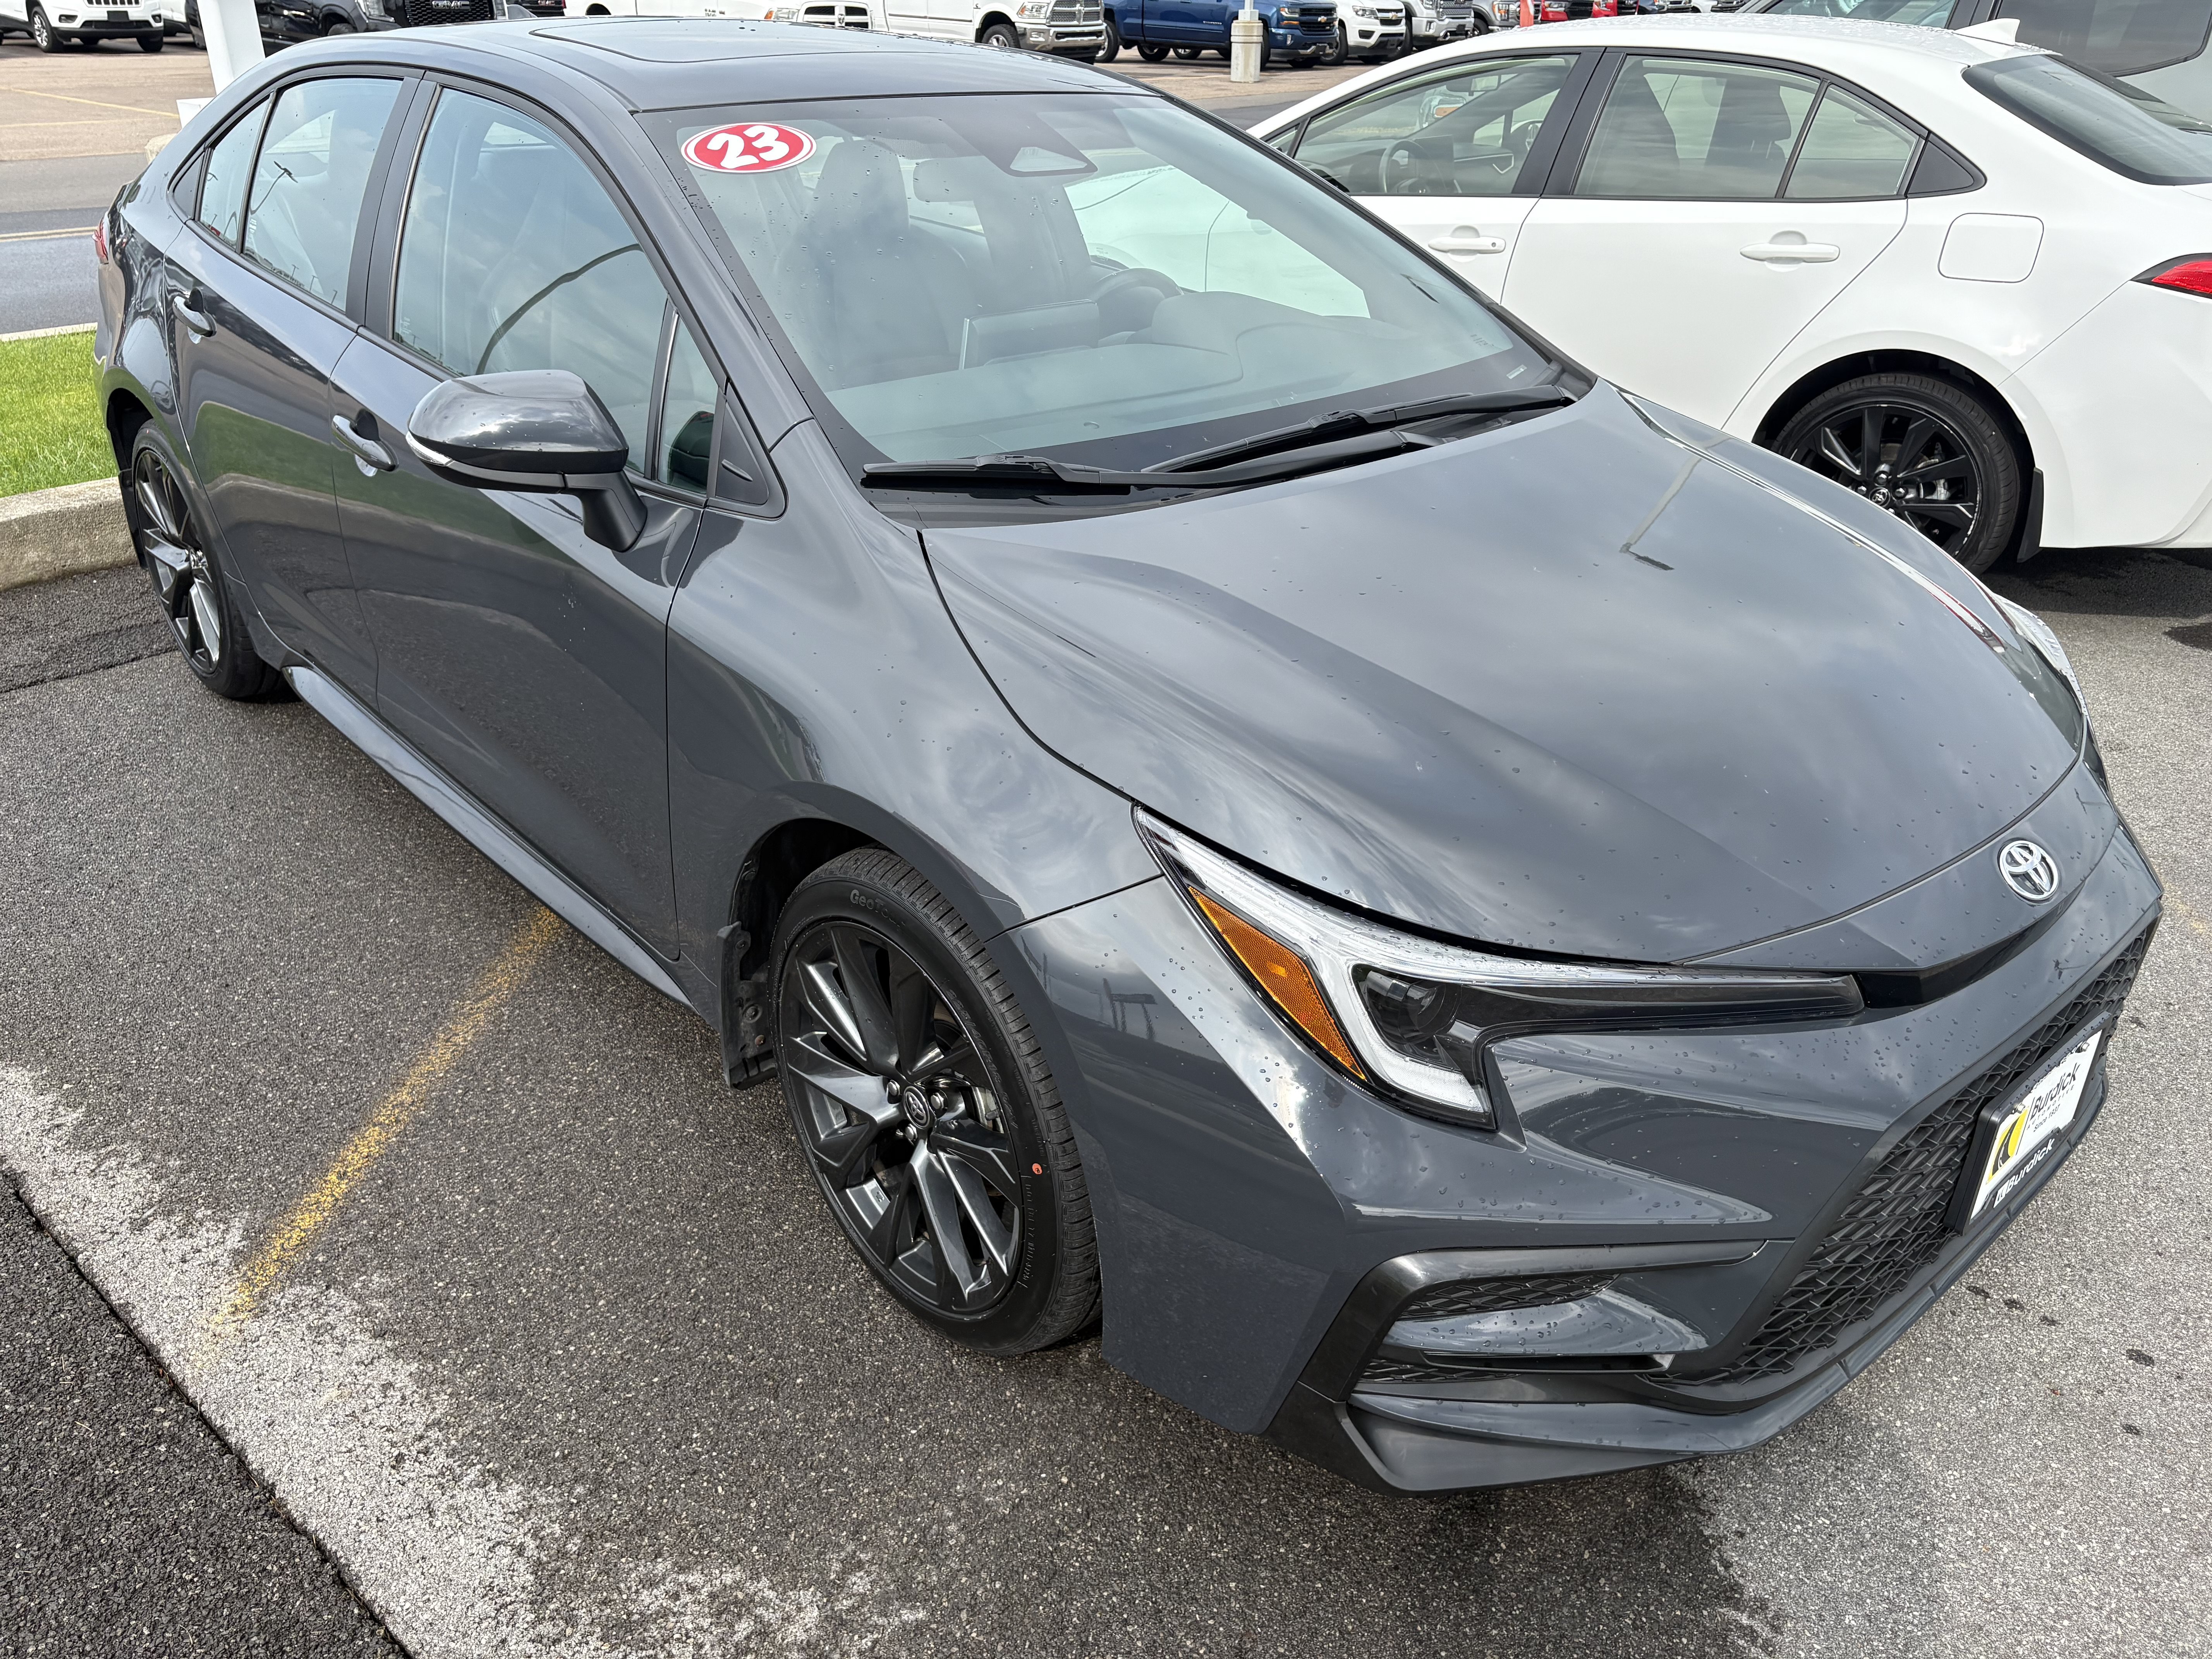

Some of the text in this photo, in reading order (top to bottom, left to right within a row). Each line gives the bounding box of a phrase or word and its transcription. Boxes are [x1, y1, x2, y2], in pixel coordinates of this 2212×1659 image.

[432, 1, 471, 9] GMC
[706, 125, 790, 169] 23
[2027, 1084, 2075, 1130] AUTOMOTIVE
[2030, 1062, 2081, 1121] Burdick
[2006, 1138, 2055, 1194] Burdick
